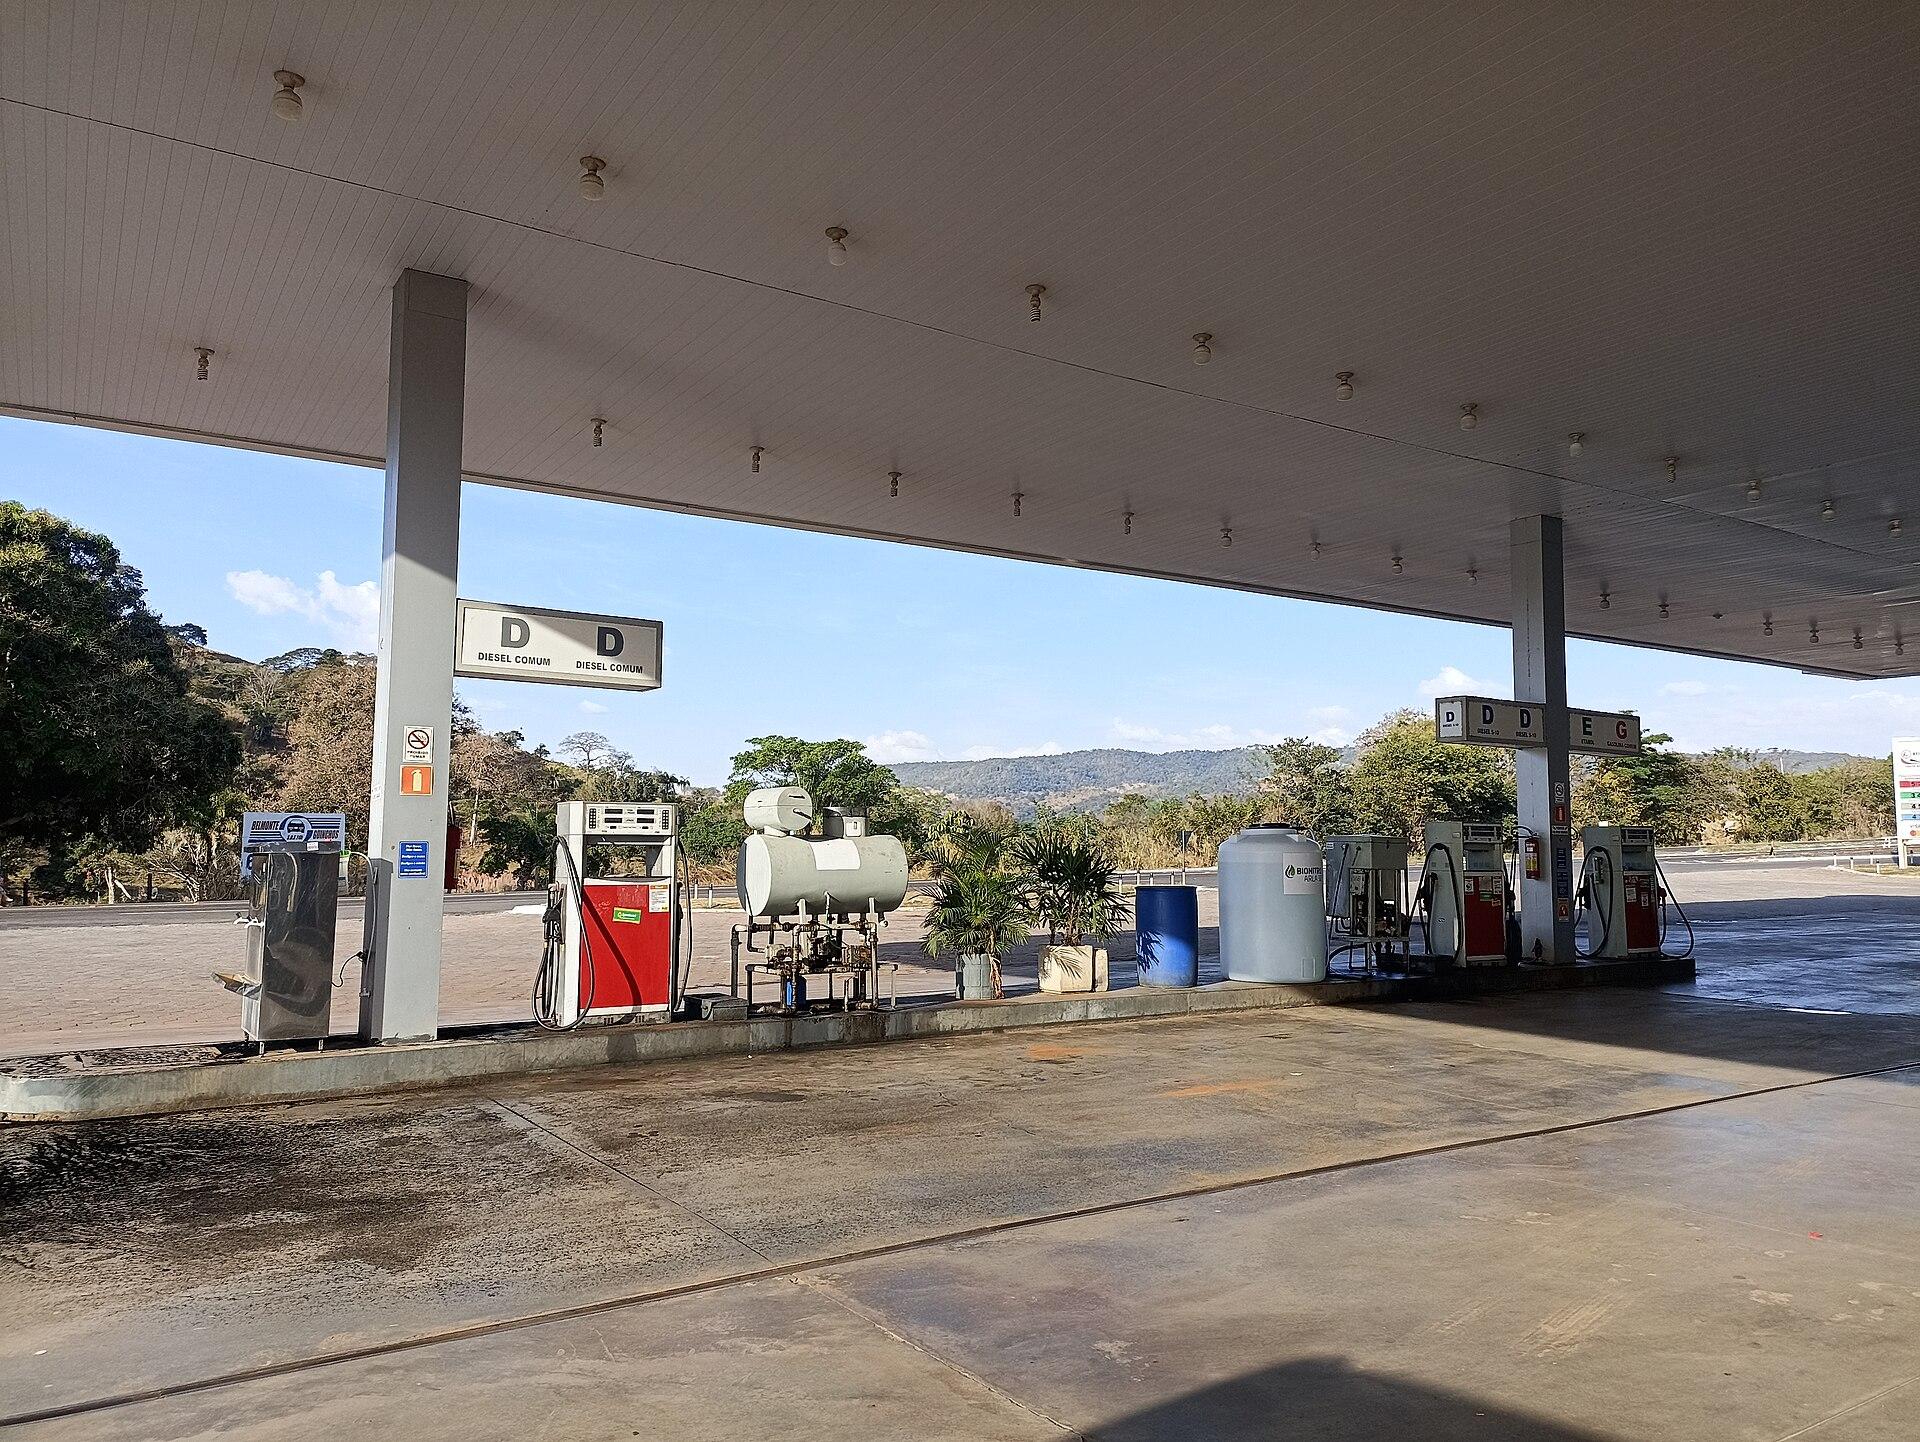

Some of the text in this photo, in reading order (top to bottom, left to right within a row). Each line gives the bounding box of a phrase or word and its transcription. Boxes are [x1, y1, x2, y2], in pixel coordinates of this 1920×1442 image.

[501, 617, 530, 648] D
[597, 626, 624, 657] D
[478, 652, 551, 666] DIESEL COMUM
[576, 661, 643, 674] DIESEL COMUM
[1446, 711, 1455, 722] D
[1482, 705, 1494, 724] D
[1520, 709, 1531, 728] D
[1582, 717, 1592, 736] E
[1616, 720, 1627, 739] G
[251, 821, 280, 831] BELMONTE
[313, 830, 339, 840] GUINCHOS
